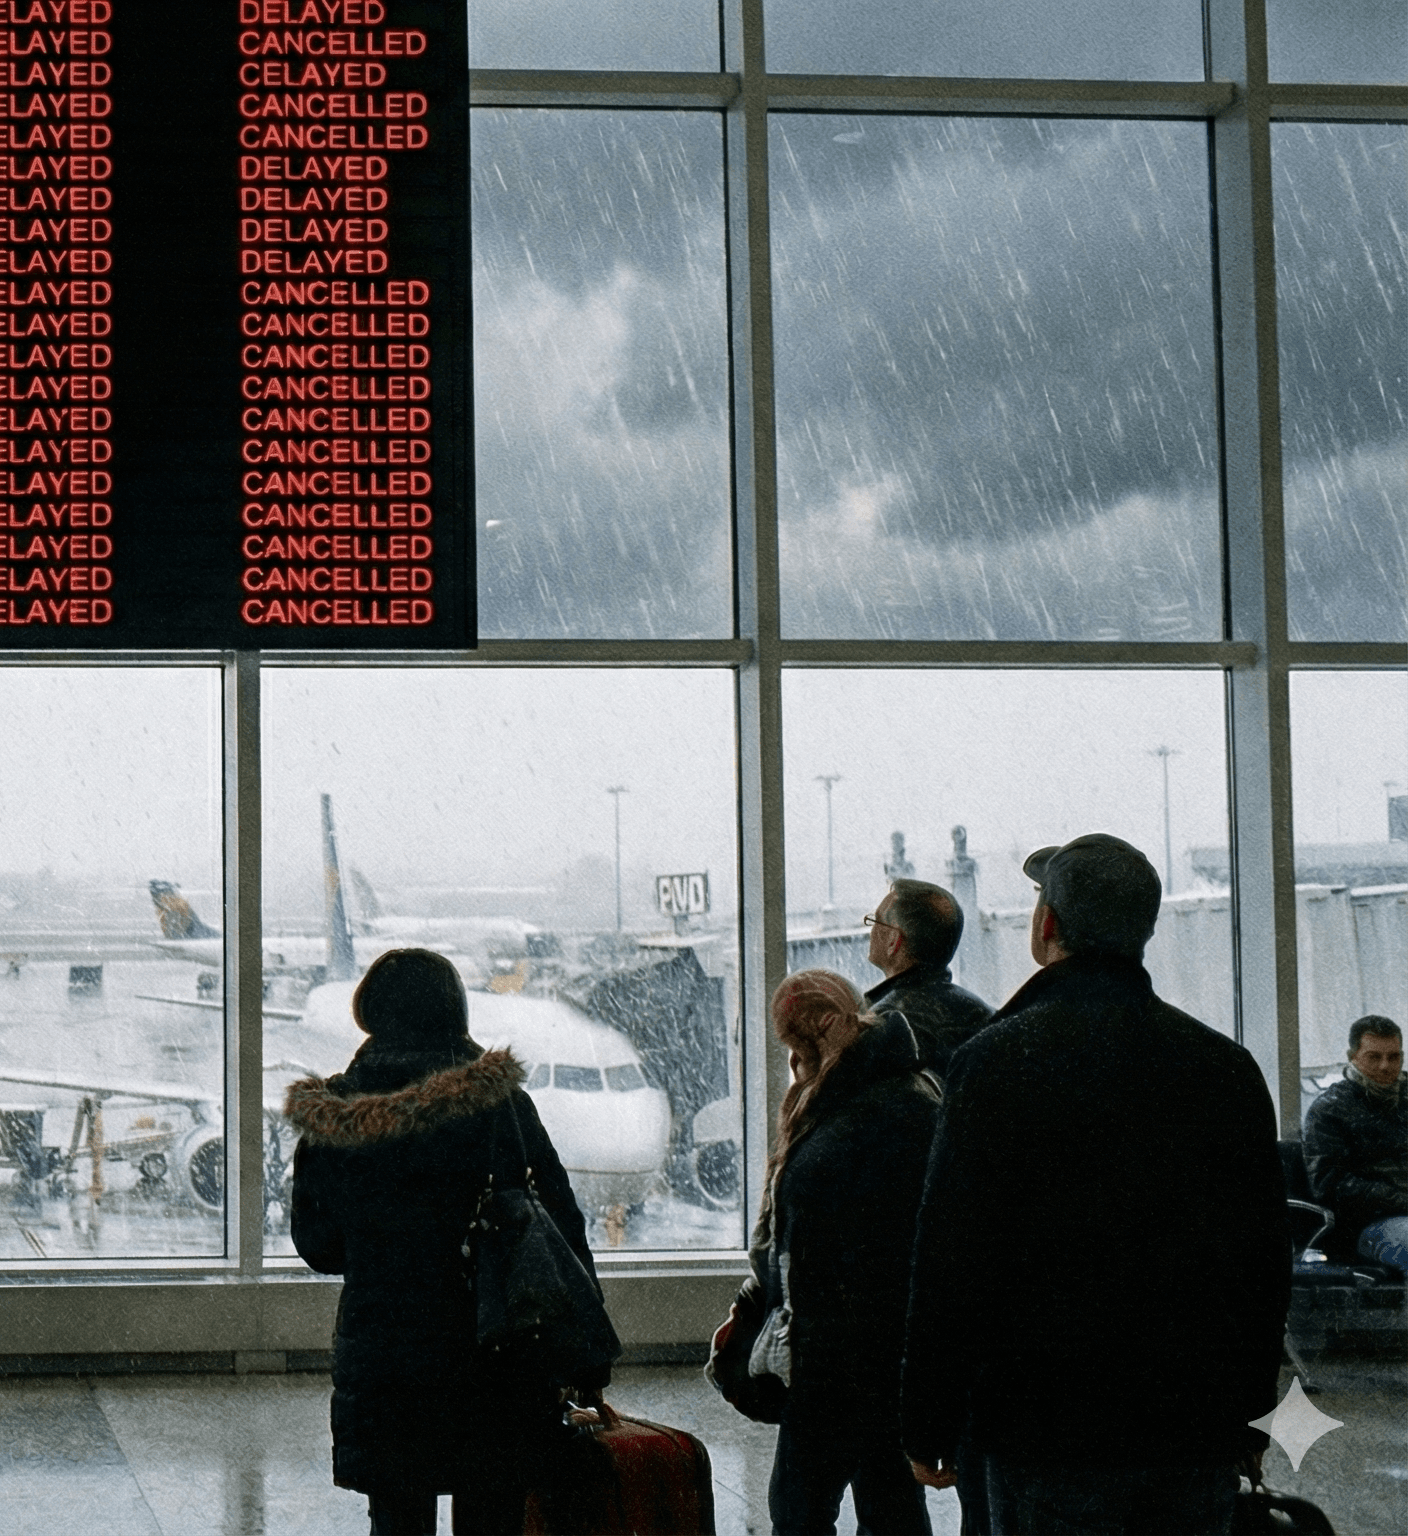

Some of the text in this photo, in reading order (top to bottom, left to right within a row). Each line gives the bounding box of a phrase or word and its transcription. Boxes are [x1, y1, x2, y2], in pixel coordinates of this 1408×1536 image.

[239, 0, 385, 24] DELAYED
[238, 30, 427, 55] CANCELLED
[239, 62, 387, 87] CELAYED
[239, 92, 428, 118] CANCELLED
[239, 124, 428, 149] CANCELLED
[240, 155, 388, 181] DELAYED
[240, 186, 388, 211] DELAYED
[241, 218, 389, 243] DELAYED
[241, 249, 388, 274] DELAYED
[242, 280, 430, 306] CANCELLED
[242, 312, 430, 337] CANCELLED
[242, 344, 430, 368] CANCELLED
[242, 375, 431, 400] CANCELLED
[242, 407, 431, 432] CANCELLED
[242, 439, 431, 464] CANCELLED
[242, 471, 432, 496] CANCELLED
[242, 502, 432, 528] CANCELLED
[242, 534, 432, 560] CANCELLED
[242, 566, 432, 592] CANCELLED
[241, 599, 433, 625] CANCELLED
